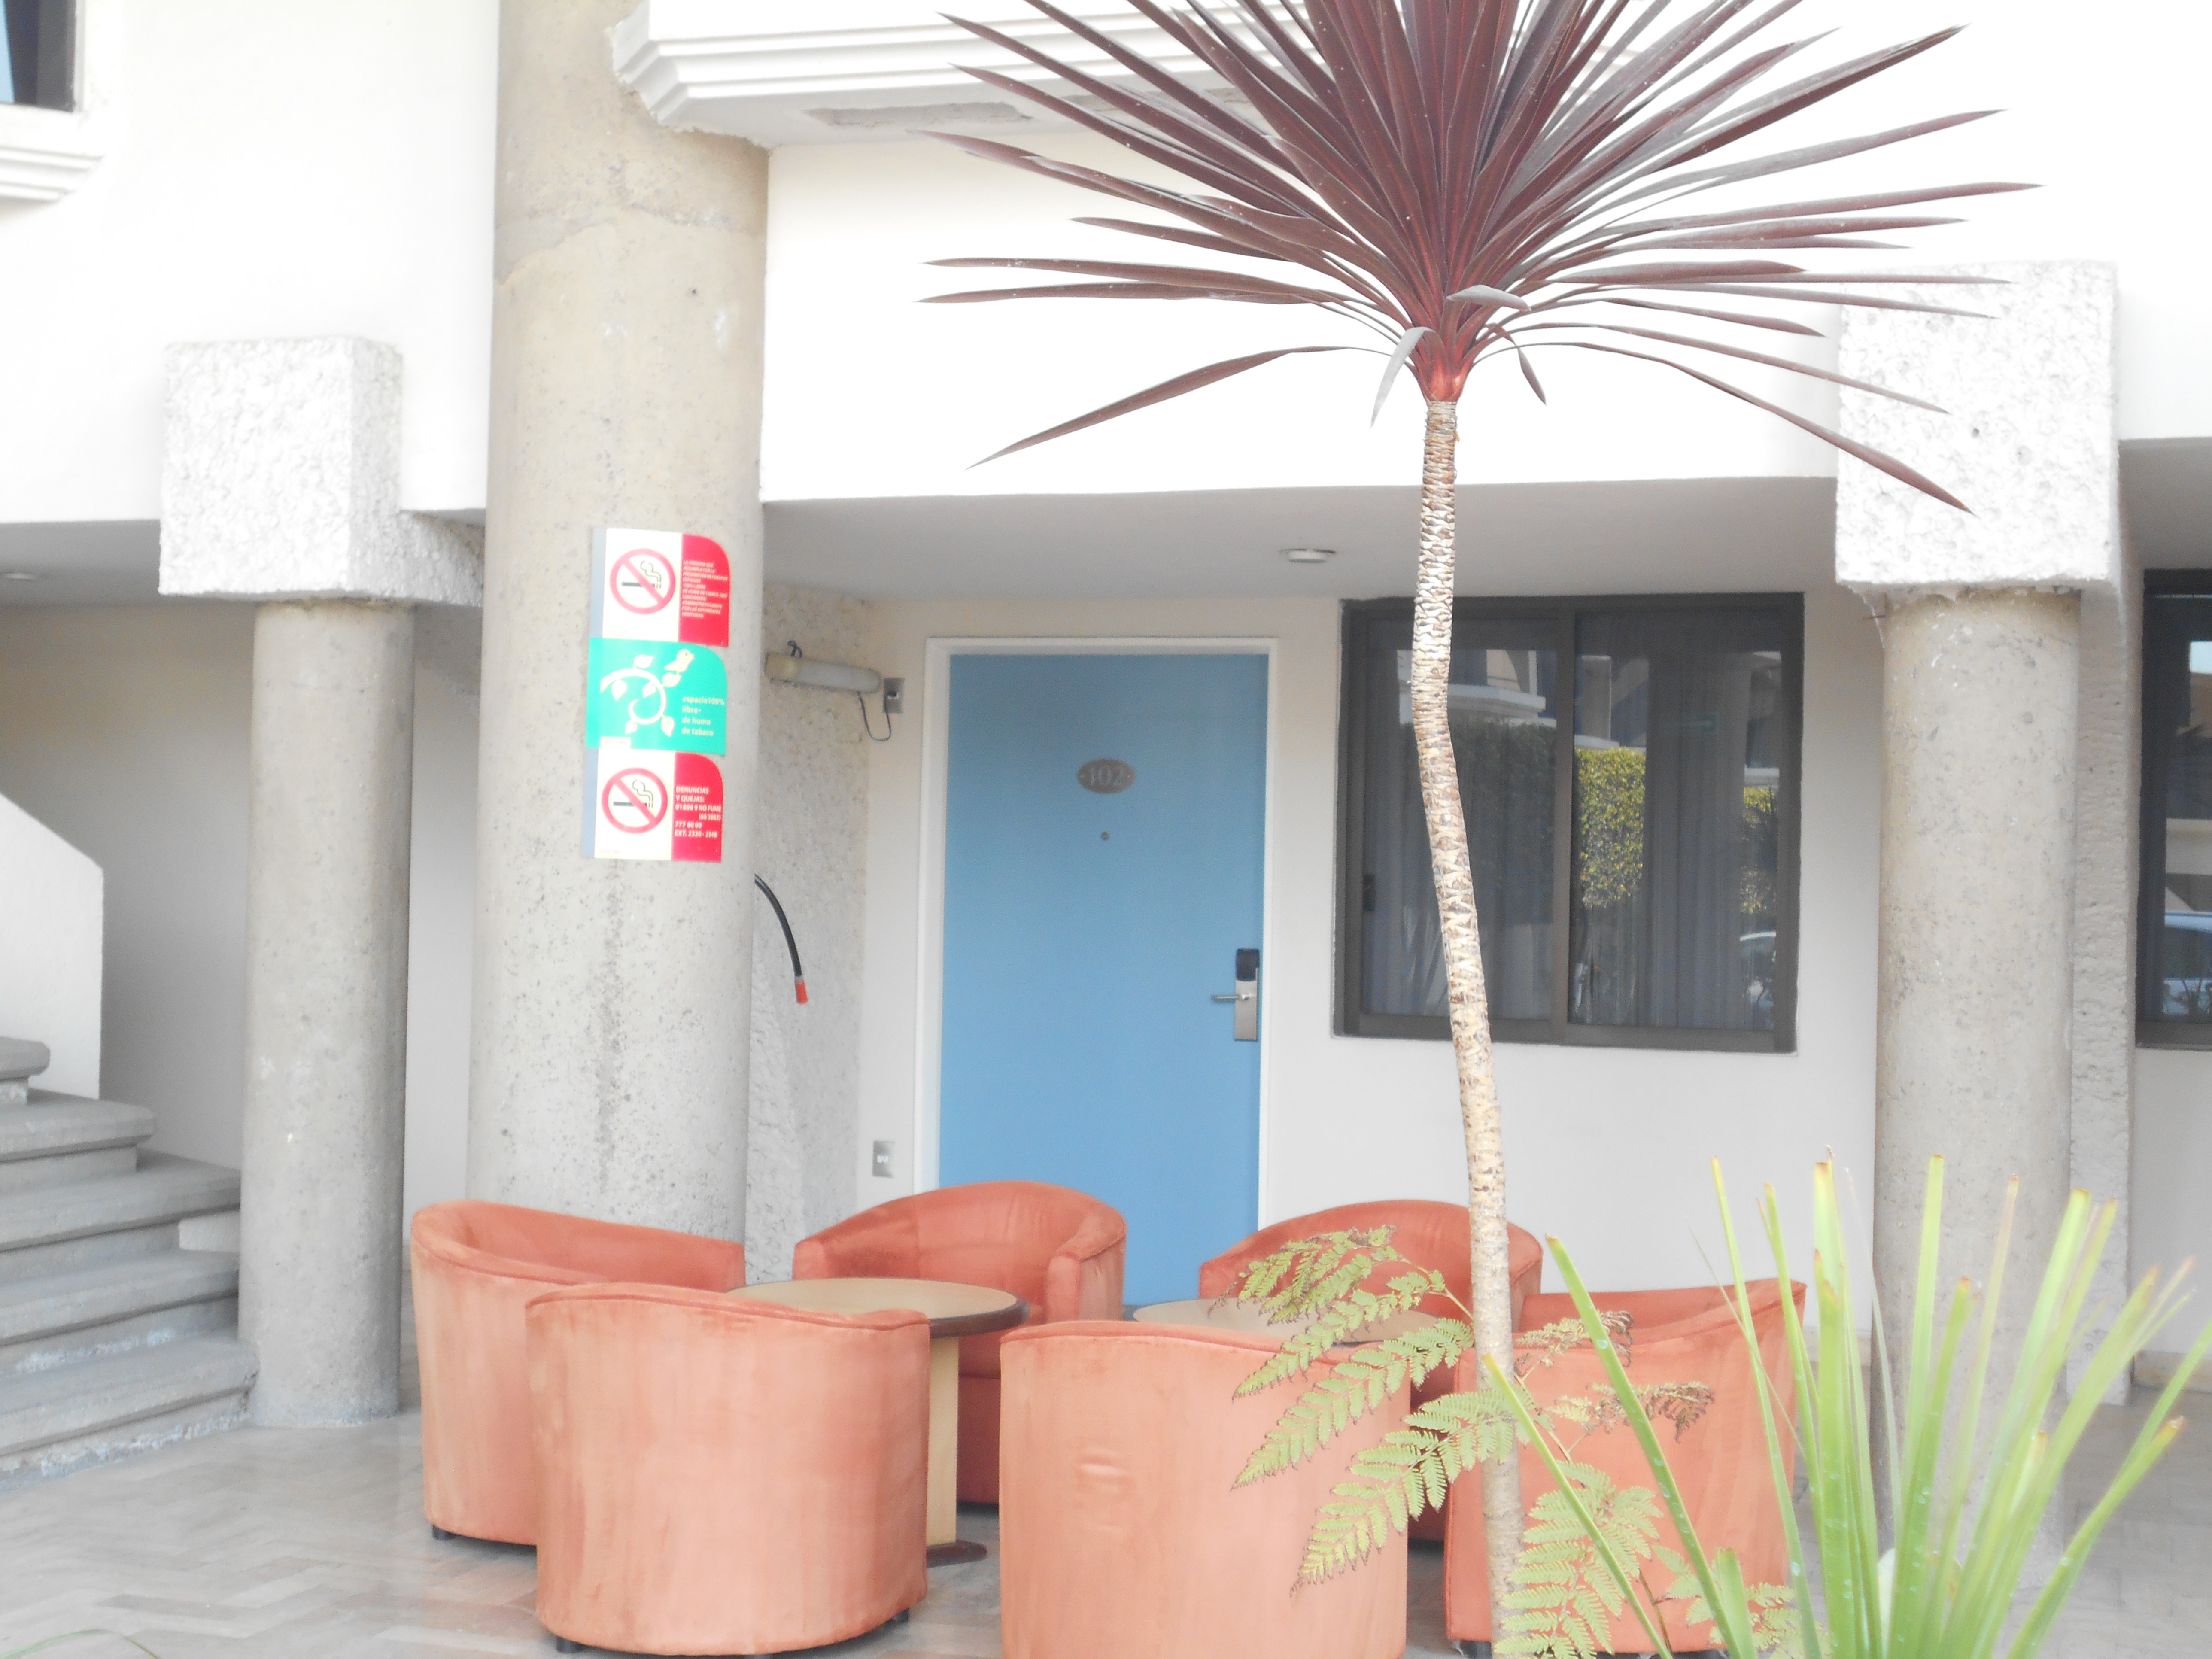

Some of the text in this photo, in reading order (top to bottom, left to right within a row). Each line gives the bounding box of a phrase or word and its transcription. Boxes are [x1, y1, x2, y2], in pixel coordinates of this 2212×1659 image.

[692, 717, 711, 725] humo
[692, 728, 714, 736] tabaco
[1089, 764, 1124, 786] 102
